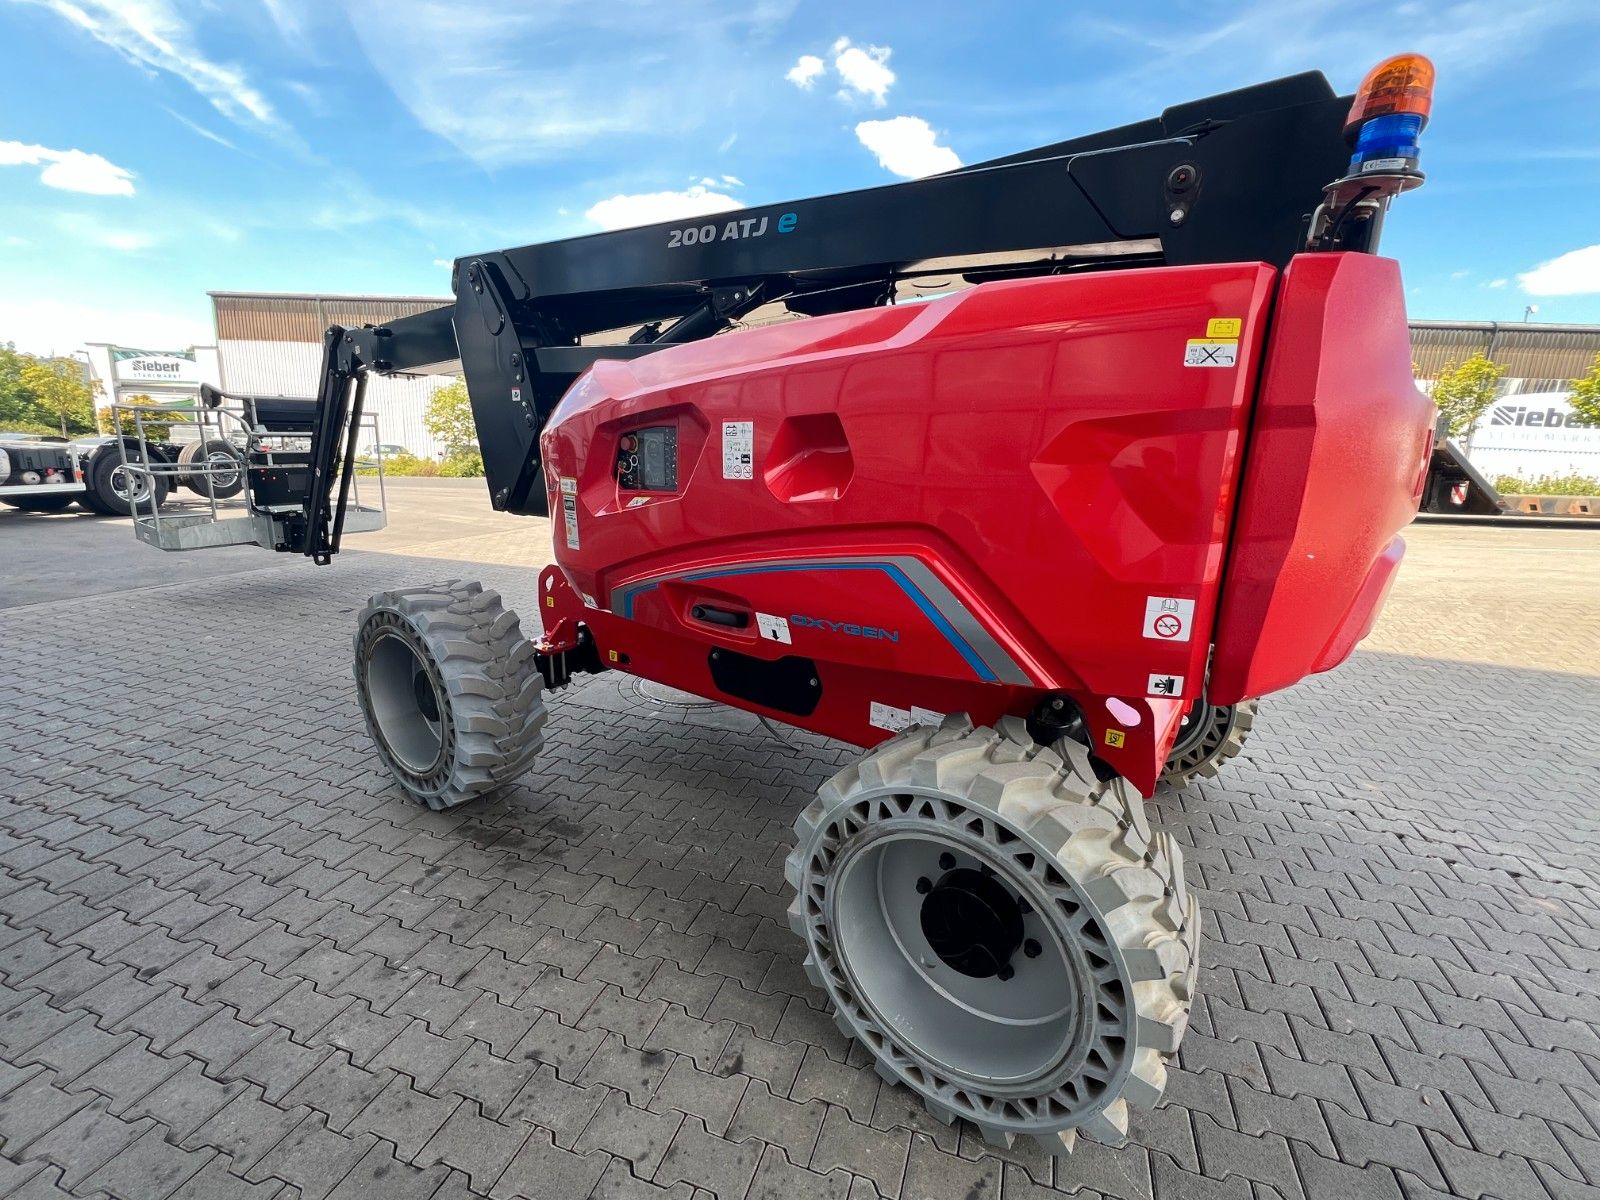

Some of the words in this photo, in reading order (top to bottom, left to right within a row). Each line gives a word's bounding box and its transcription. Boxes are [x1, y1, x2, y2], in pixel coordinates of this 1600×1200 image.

[667, 225, 717, 248] 200
[721, 216, 769, 241] ATJ
[777, 212, 798, 233] e
[132, 360, 180, 372] Siebert
[790, 614, 899, 642] OXYGEN
